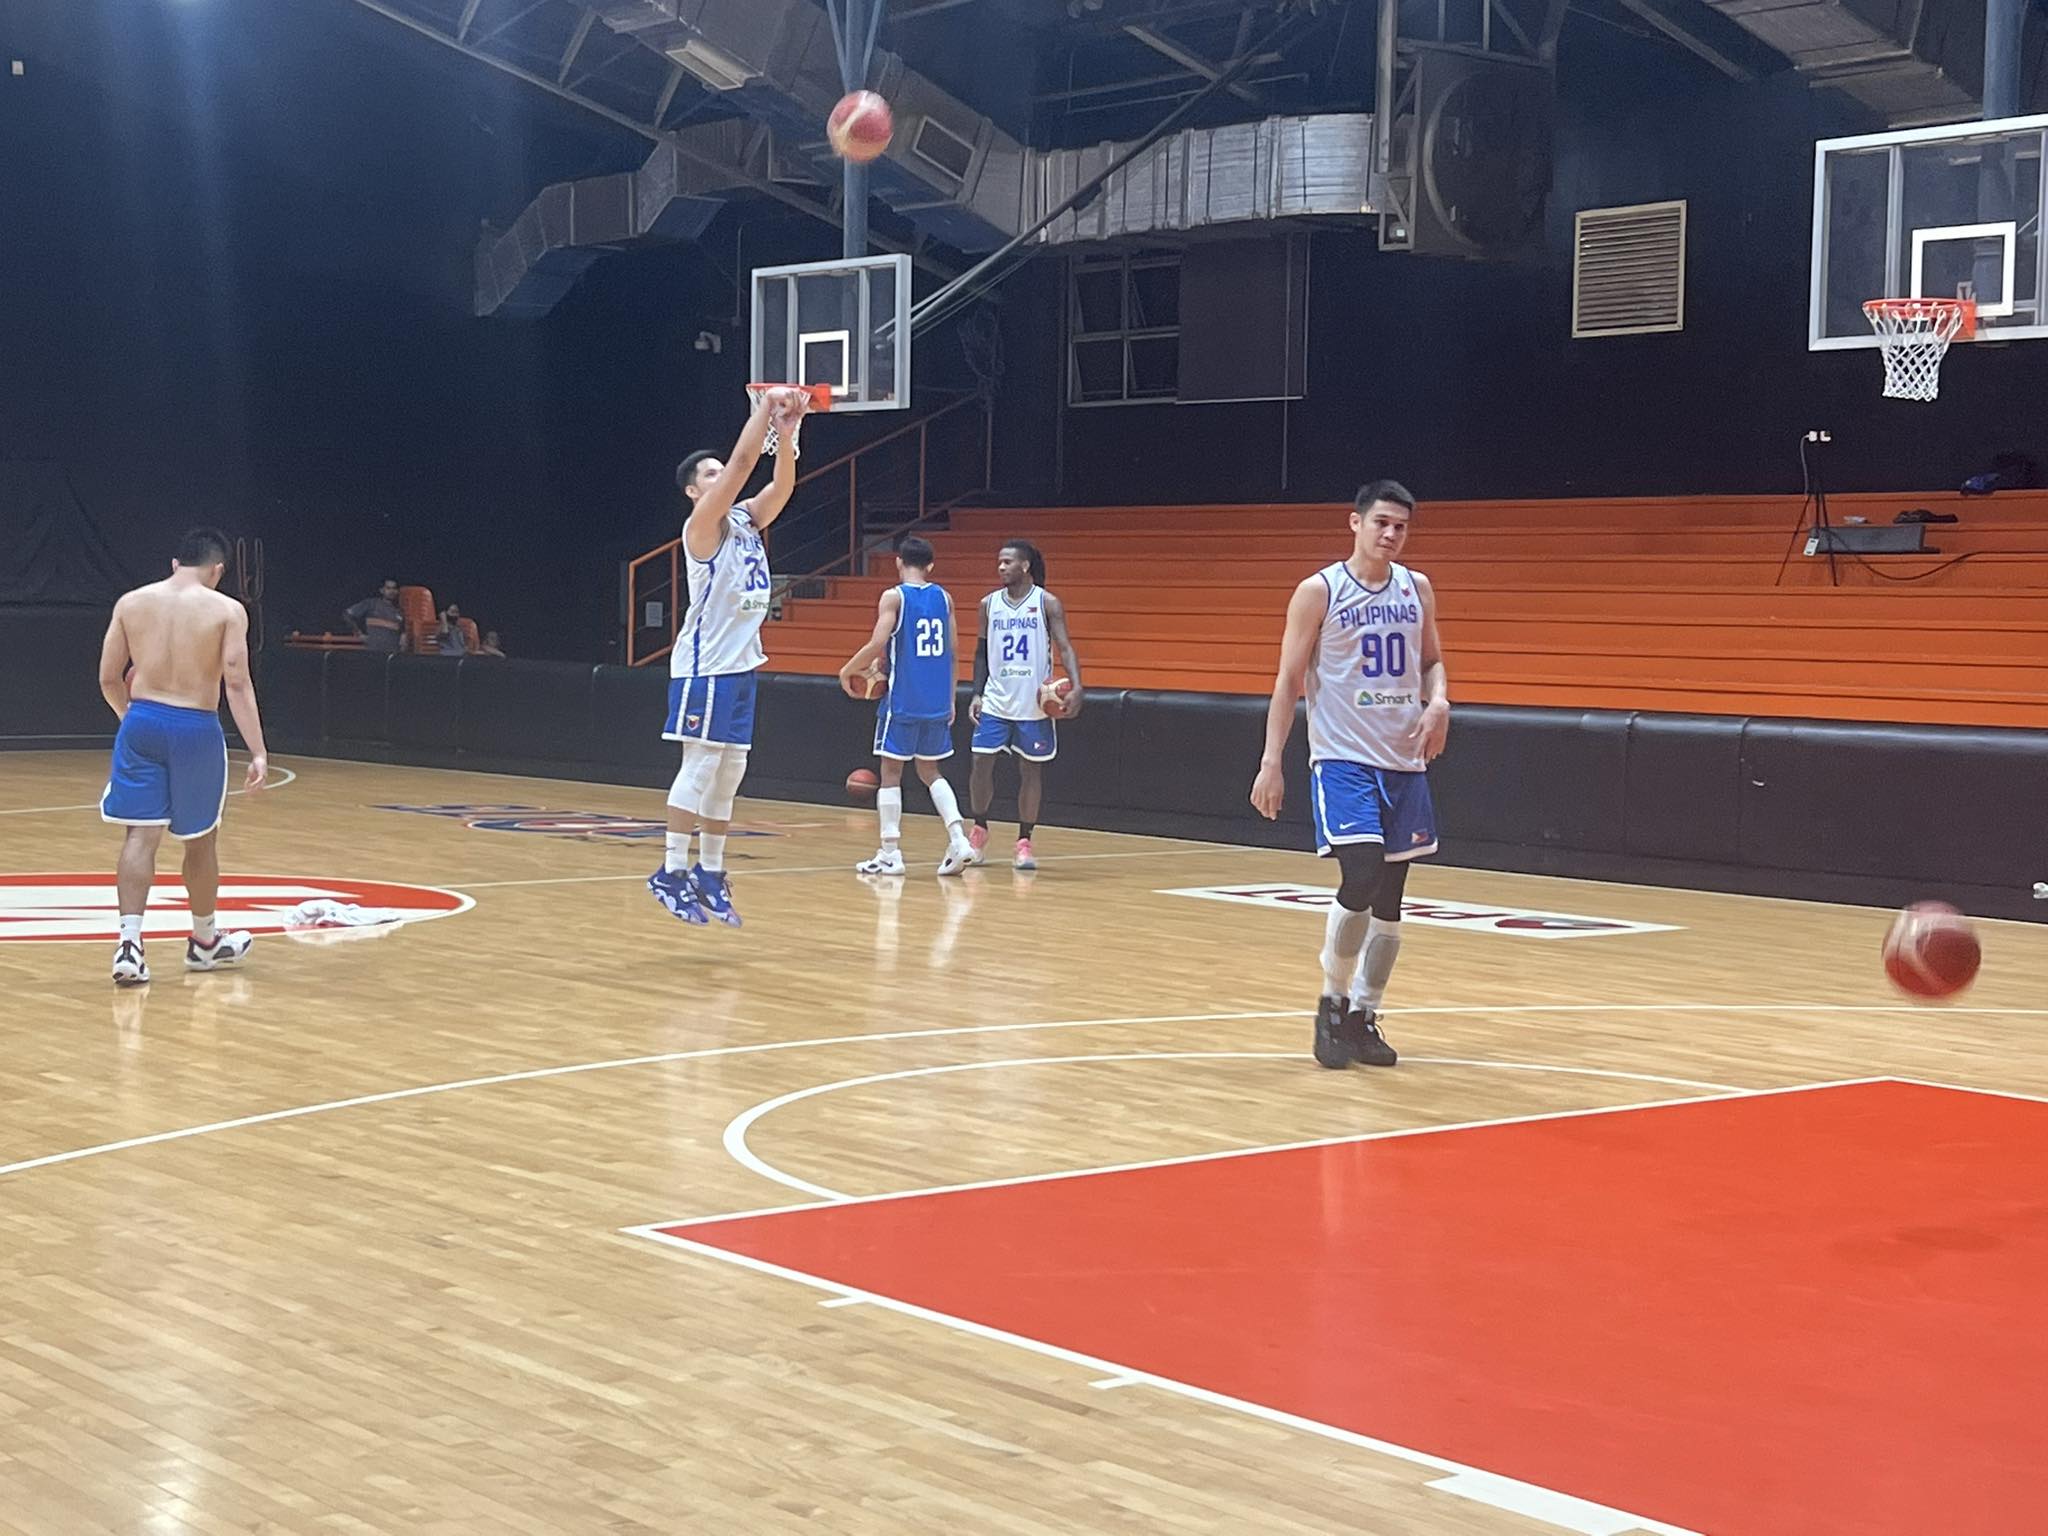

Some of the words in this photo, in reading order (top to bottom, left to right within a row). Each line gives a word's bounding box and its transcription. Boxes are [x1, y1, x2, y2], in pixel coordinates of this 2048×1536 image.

[993, 616, 1038, 631] PILIPINAS
[1339, 603, 1418, 629] PILIPINAS
[916, 618, 944, 657] 23
[1002, 633, 1029, 661] 24
[1361, 632, 1406, 677] 90
[1009, 667, 1032, 677] Smart
[1374, 692, 1413, 705] Smart
